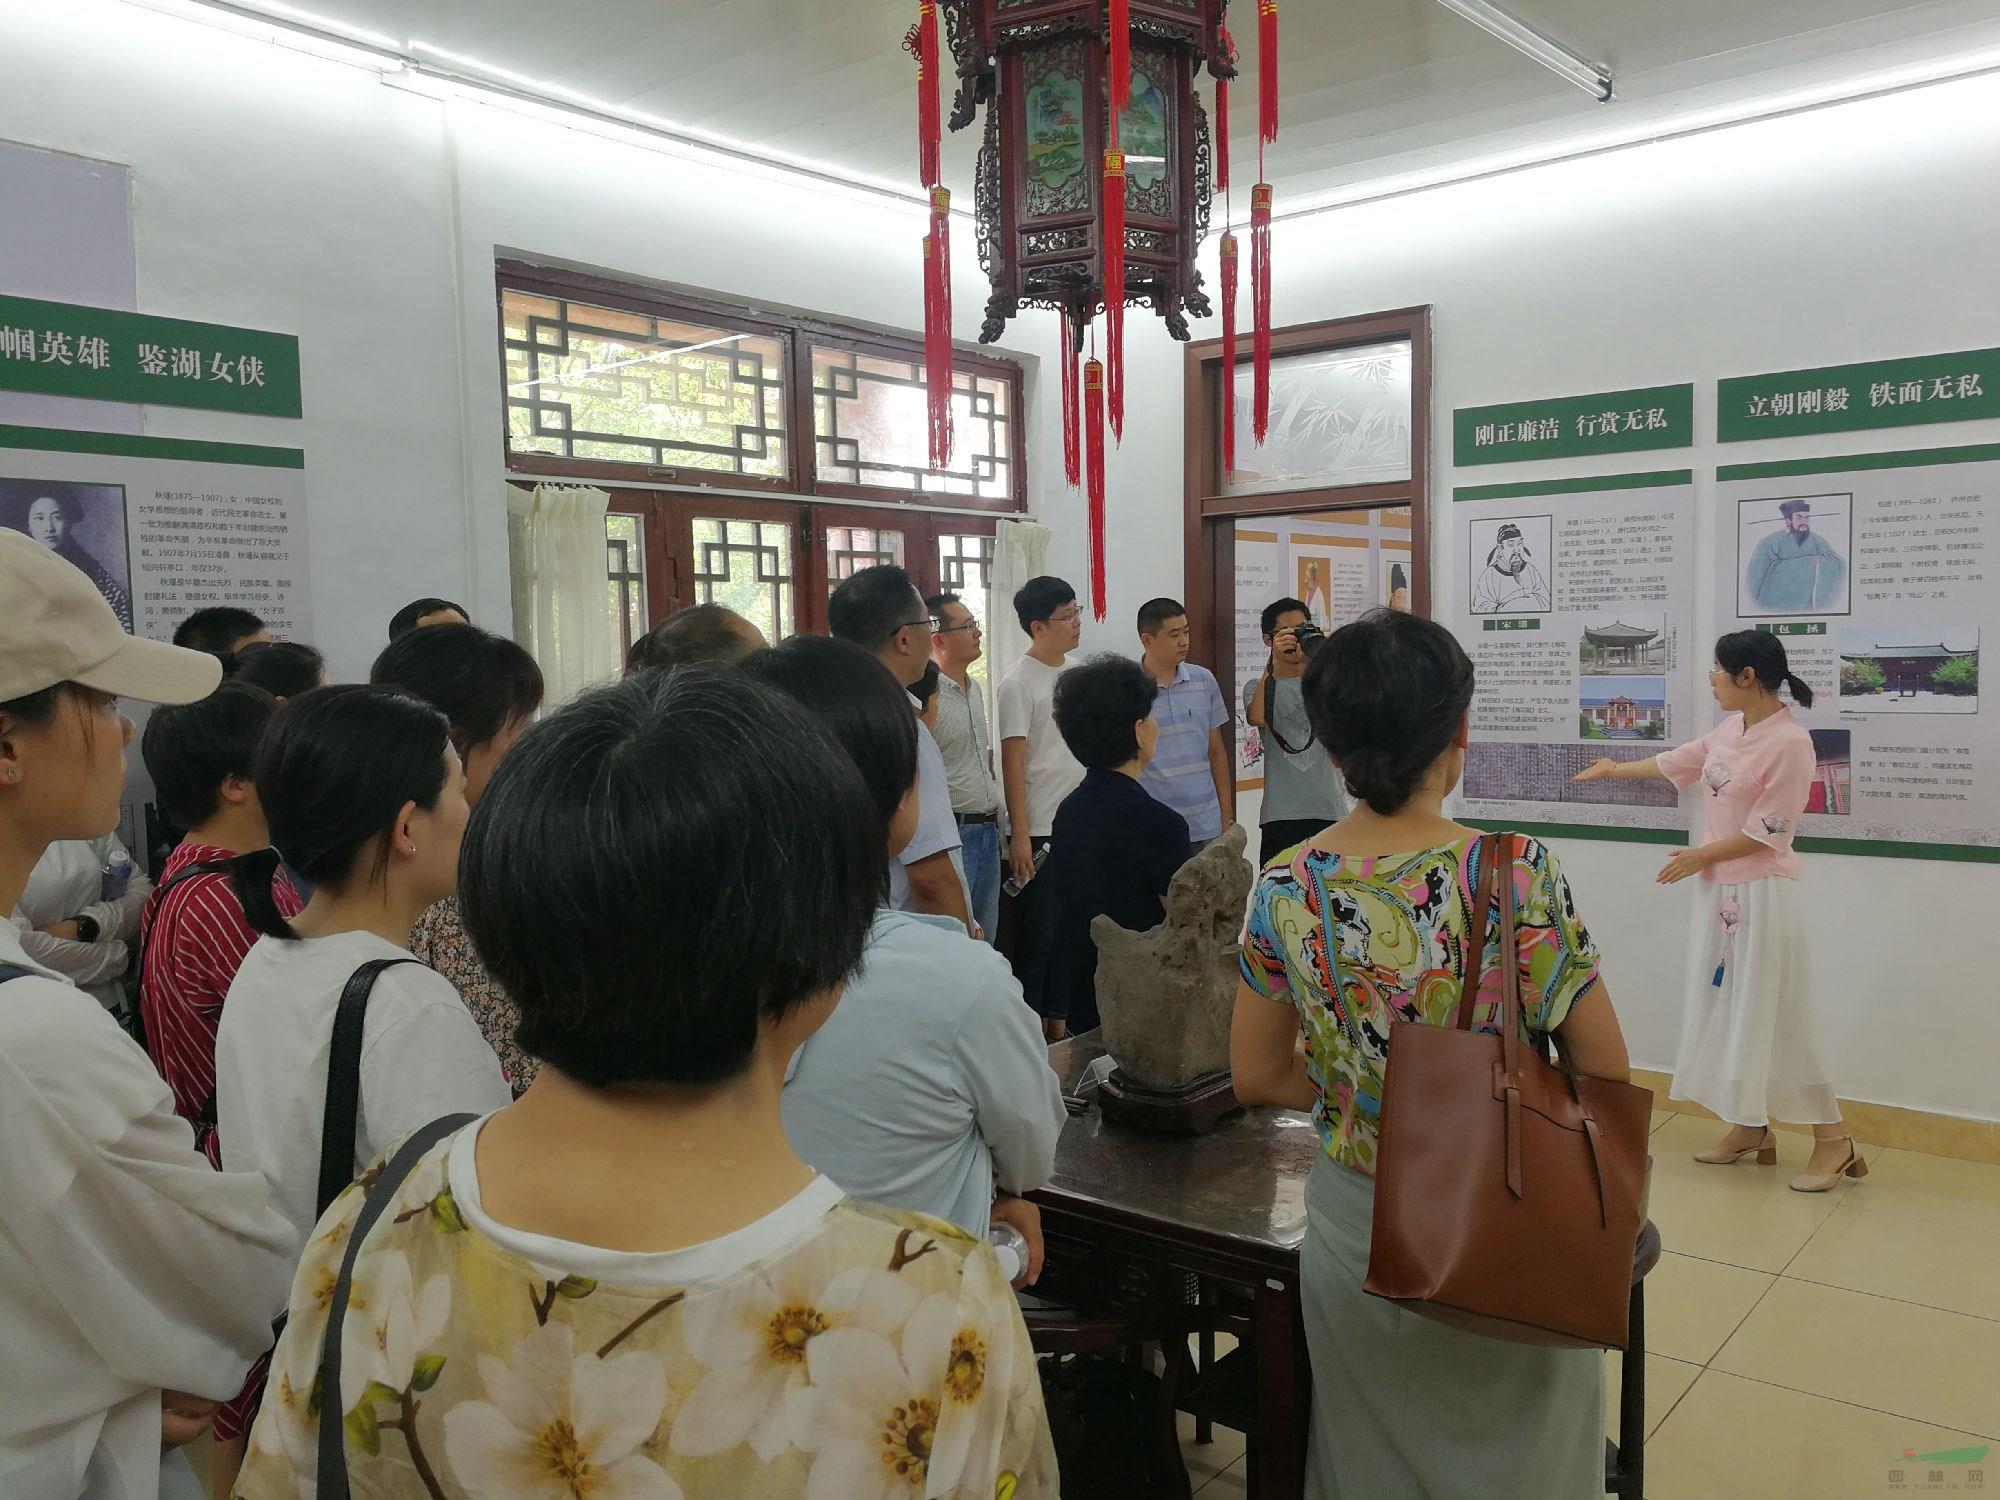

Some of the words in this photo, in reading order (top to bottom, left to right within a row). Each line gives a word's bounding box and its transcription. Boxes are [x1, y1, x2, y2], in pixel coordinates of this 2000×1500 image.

[0, 325, 111, 370] 帼英雄
[137, 343, 265, 387] 鉴湖女侠
[1744, 387, 1849, 419] 立朝刚毅
[1869, 374, 1983, 408] 铁面无私
[1474, 417, 1560, 447] 刚正廉洁
[1575, 408, 1668, 437] 行赏无私
